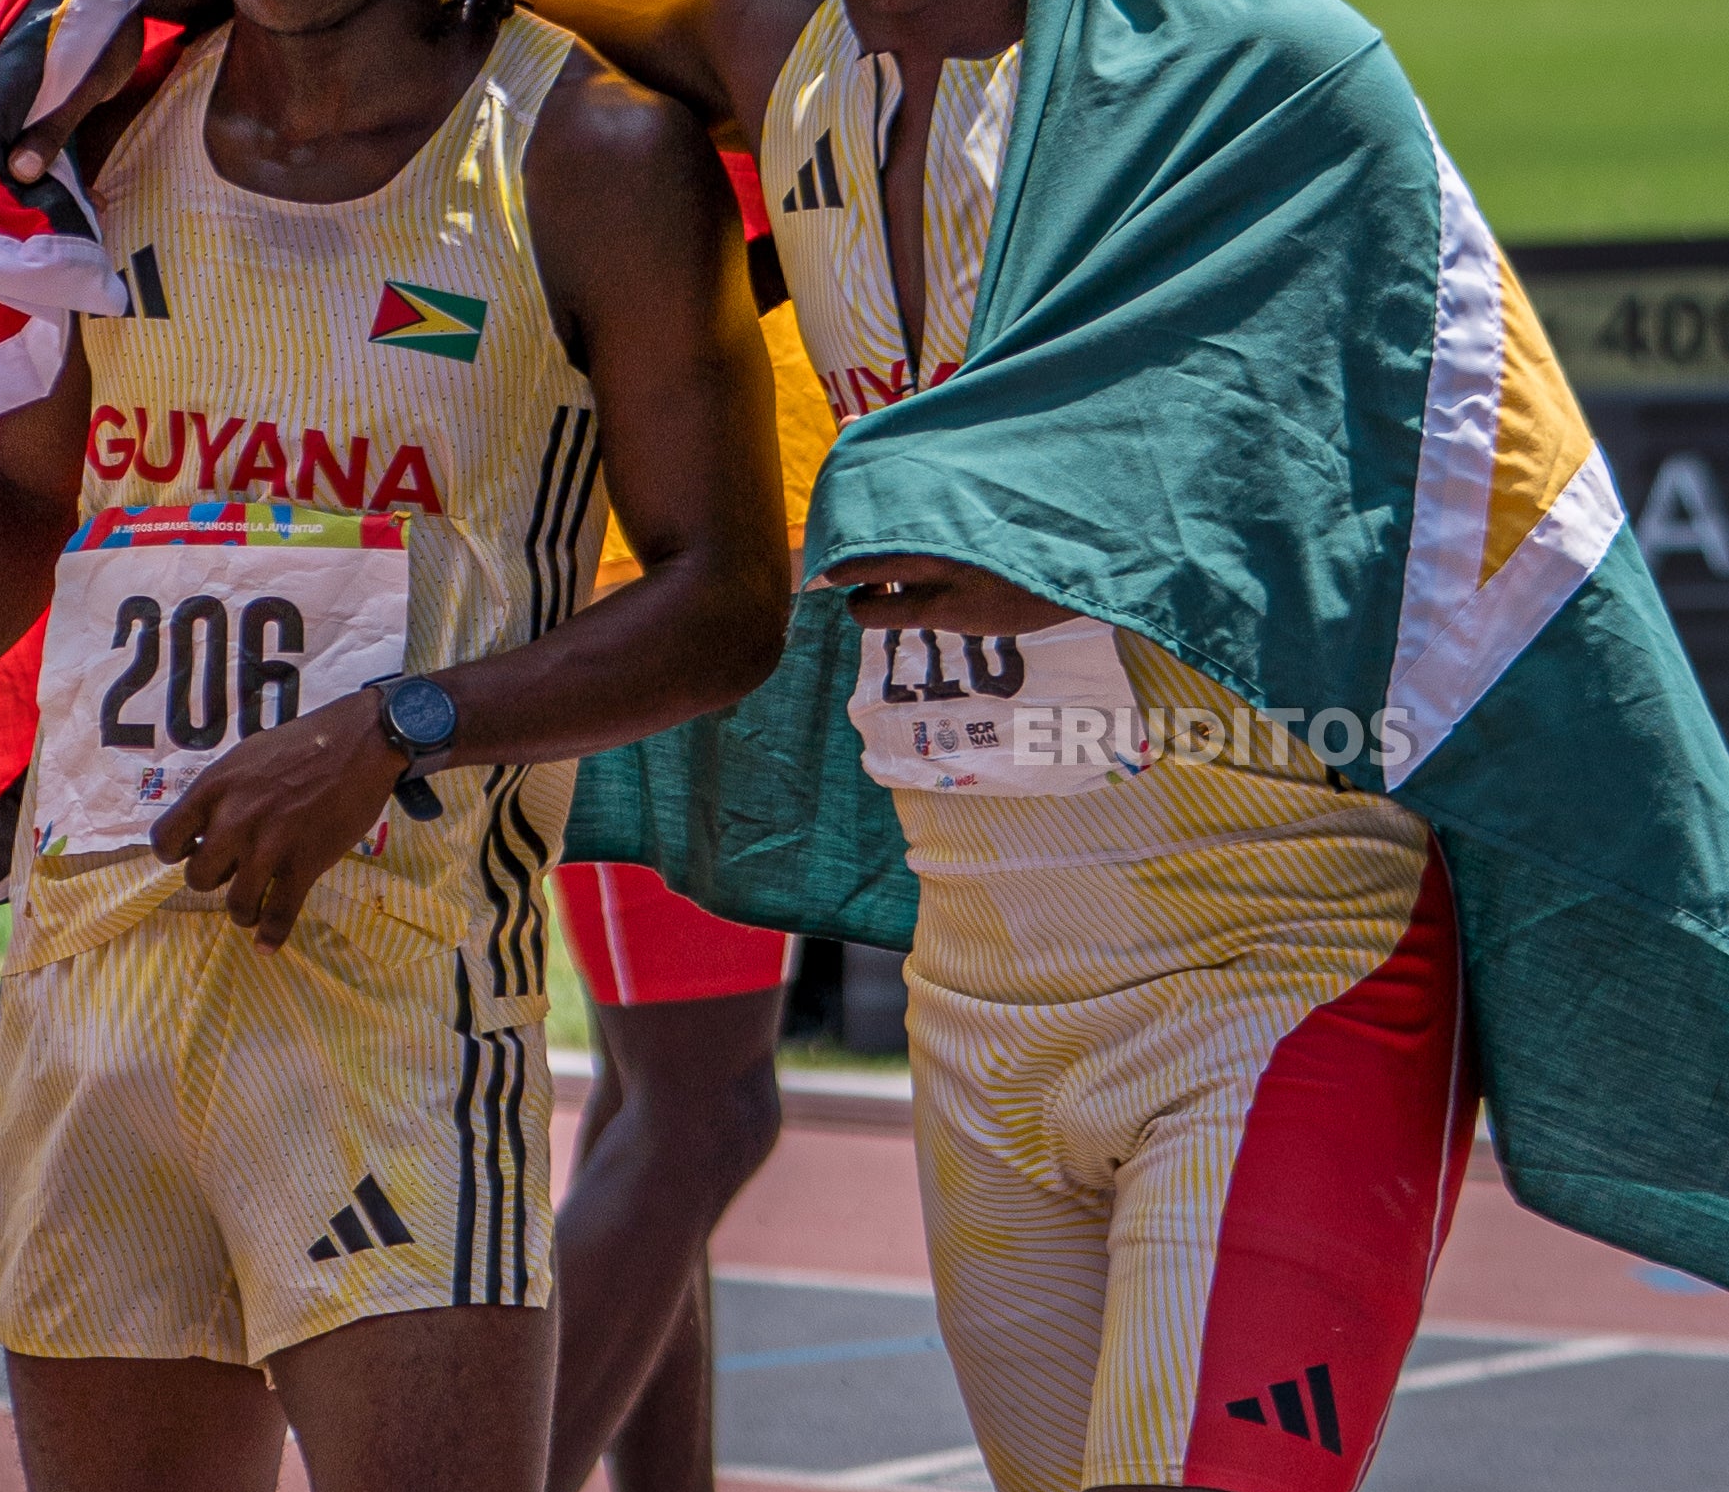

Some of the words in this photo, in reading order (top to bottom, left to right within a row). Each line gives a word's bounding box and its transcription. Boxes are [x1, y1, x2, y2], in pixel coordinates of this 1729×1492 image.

[87, 405, 443, 514] GUYANA
[122, 522, 153, 534] JUEGOS
[153, 521, 234, 532] SURAMERICANOS
[235, 522, 249, 532] DE
[250, 522, 264, 532] LA
[265, 522, 324, 534] JUVENTUD
[99, 595, 304, 751] 206
[965, 721, 995, 735] BOR
[969, 733, 999, 746] NAN
